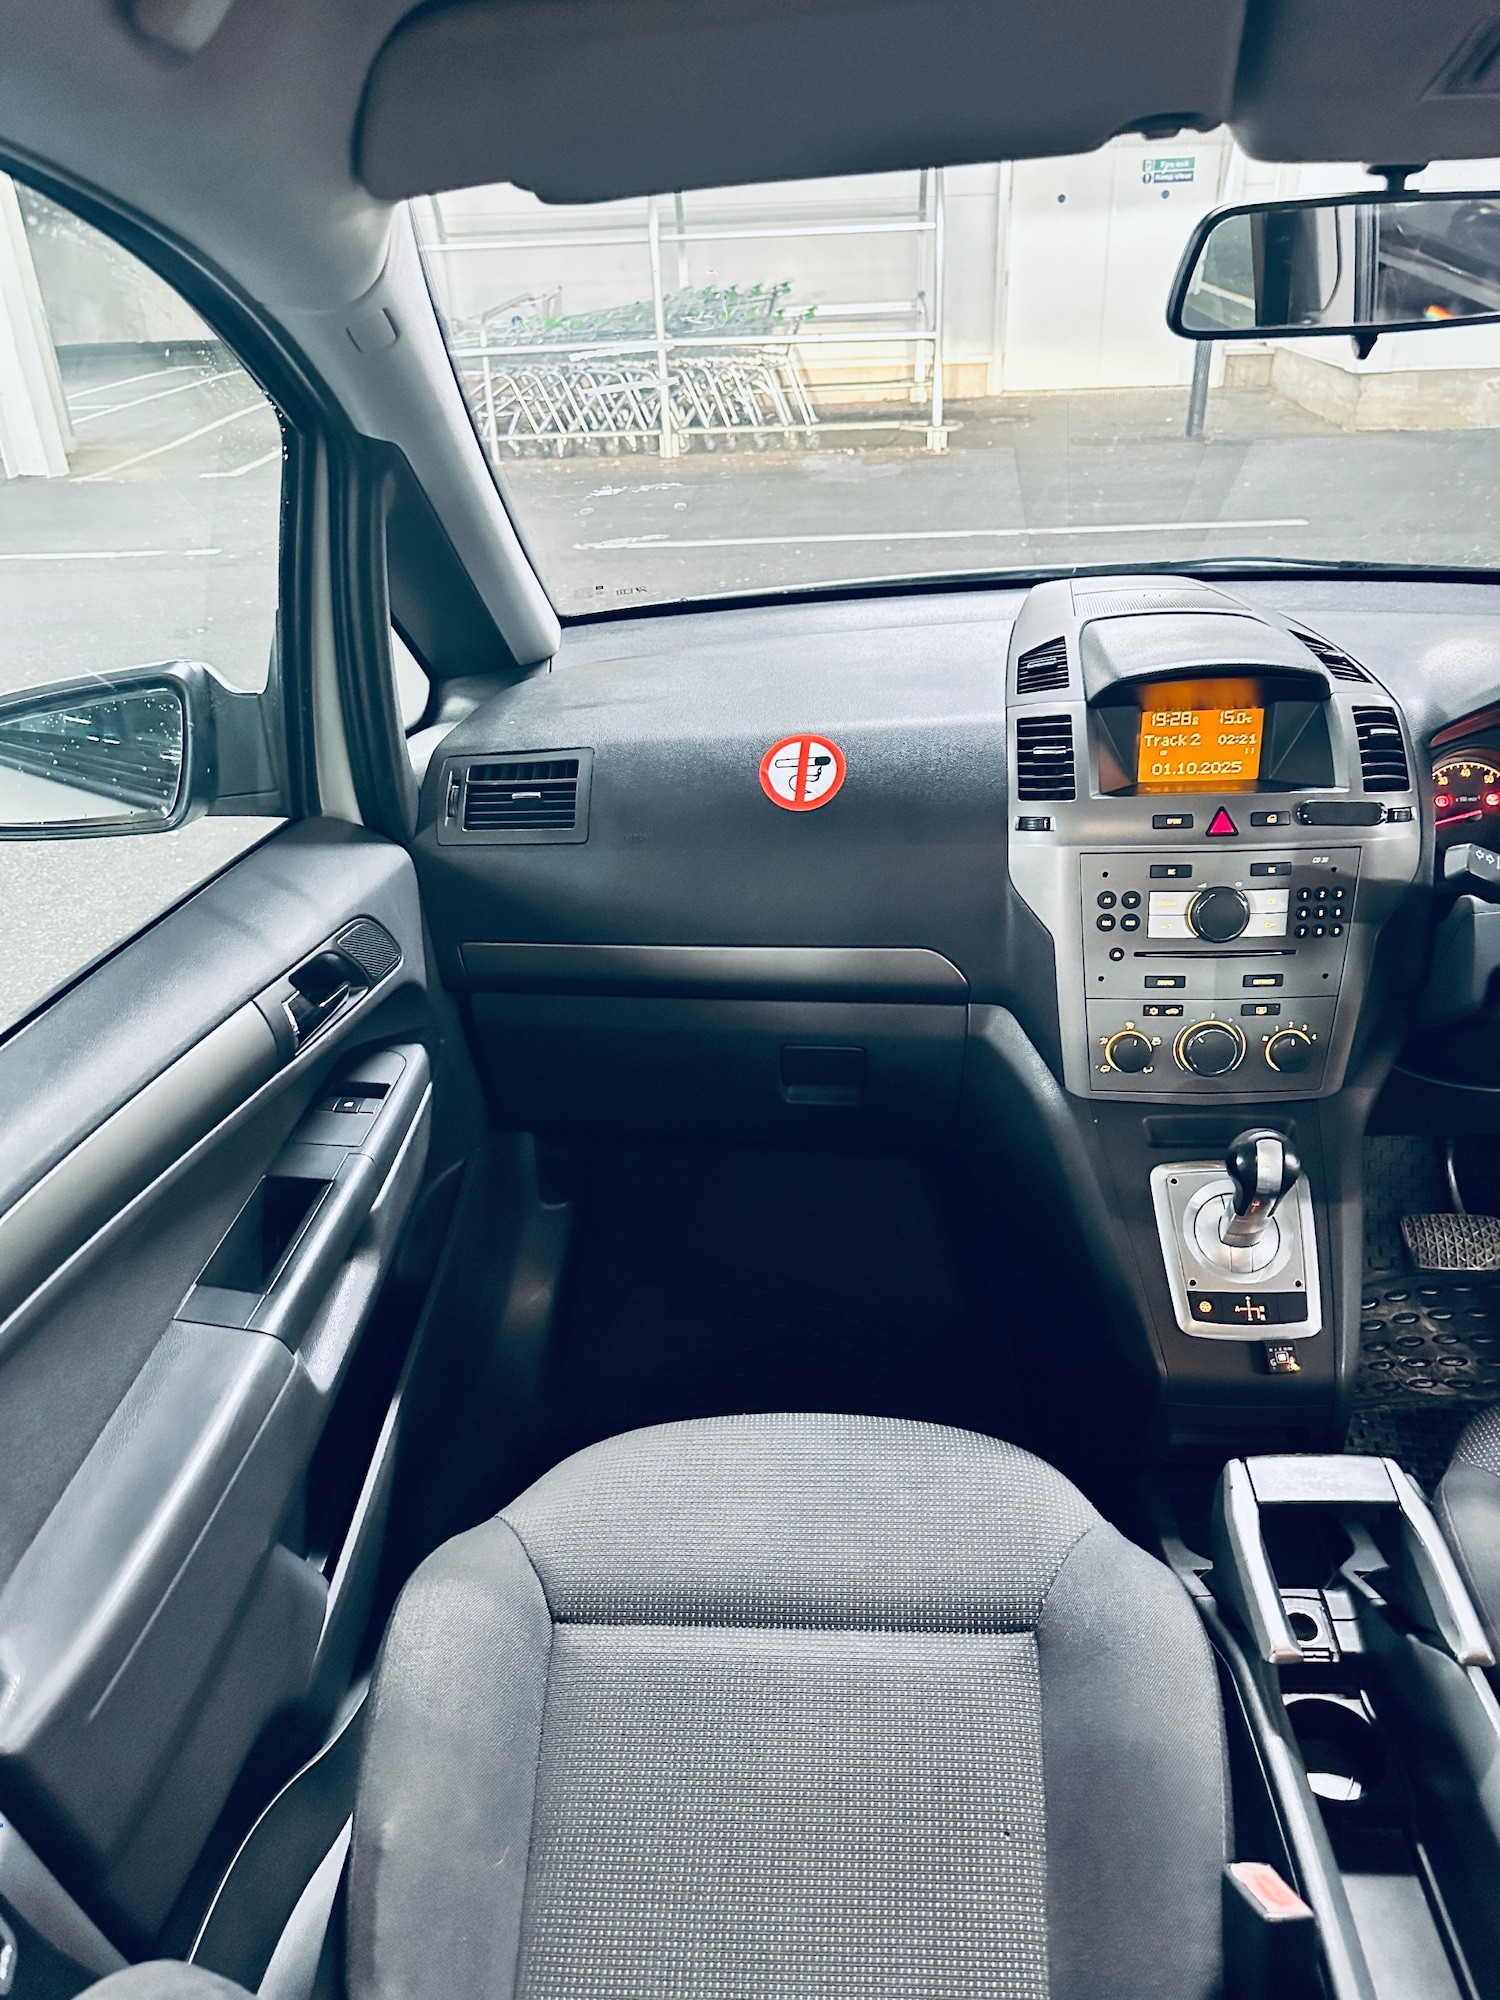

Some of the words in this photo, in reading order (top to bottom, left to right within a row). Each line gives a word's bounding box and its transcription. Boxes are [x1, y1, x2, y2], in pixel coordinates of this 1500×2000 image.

[1155, 173, 1173, 181] Keep
[1174, 172, 1192, 180] clear
[1151, 711, 1192, 727] 19:28
[1143, 733, 1187, 747] Track
[1190, 733, 1201, 746] 2
[1217, 733, 1257, 745] 02:21
[1151, 760, 1243, 776] 01.10.2025
